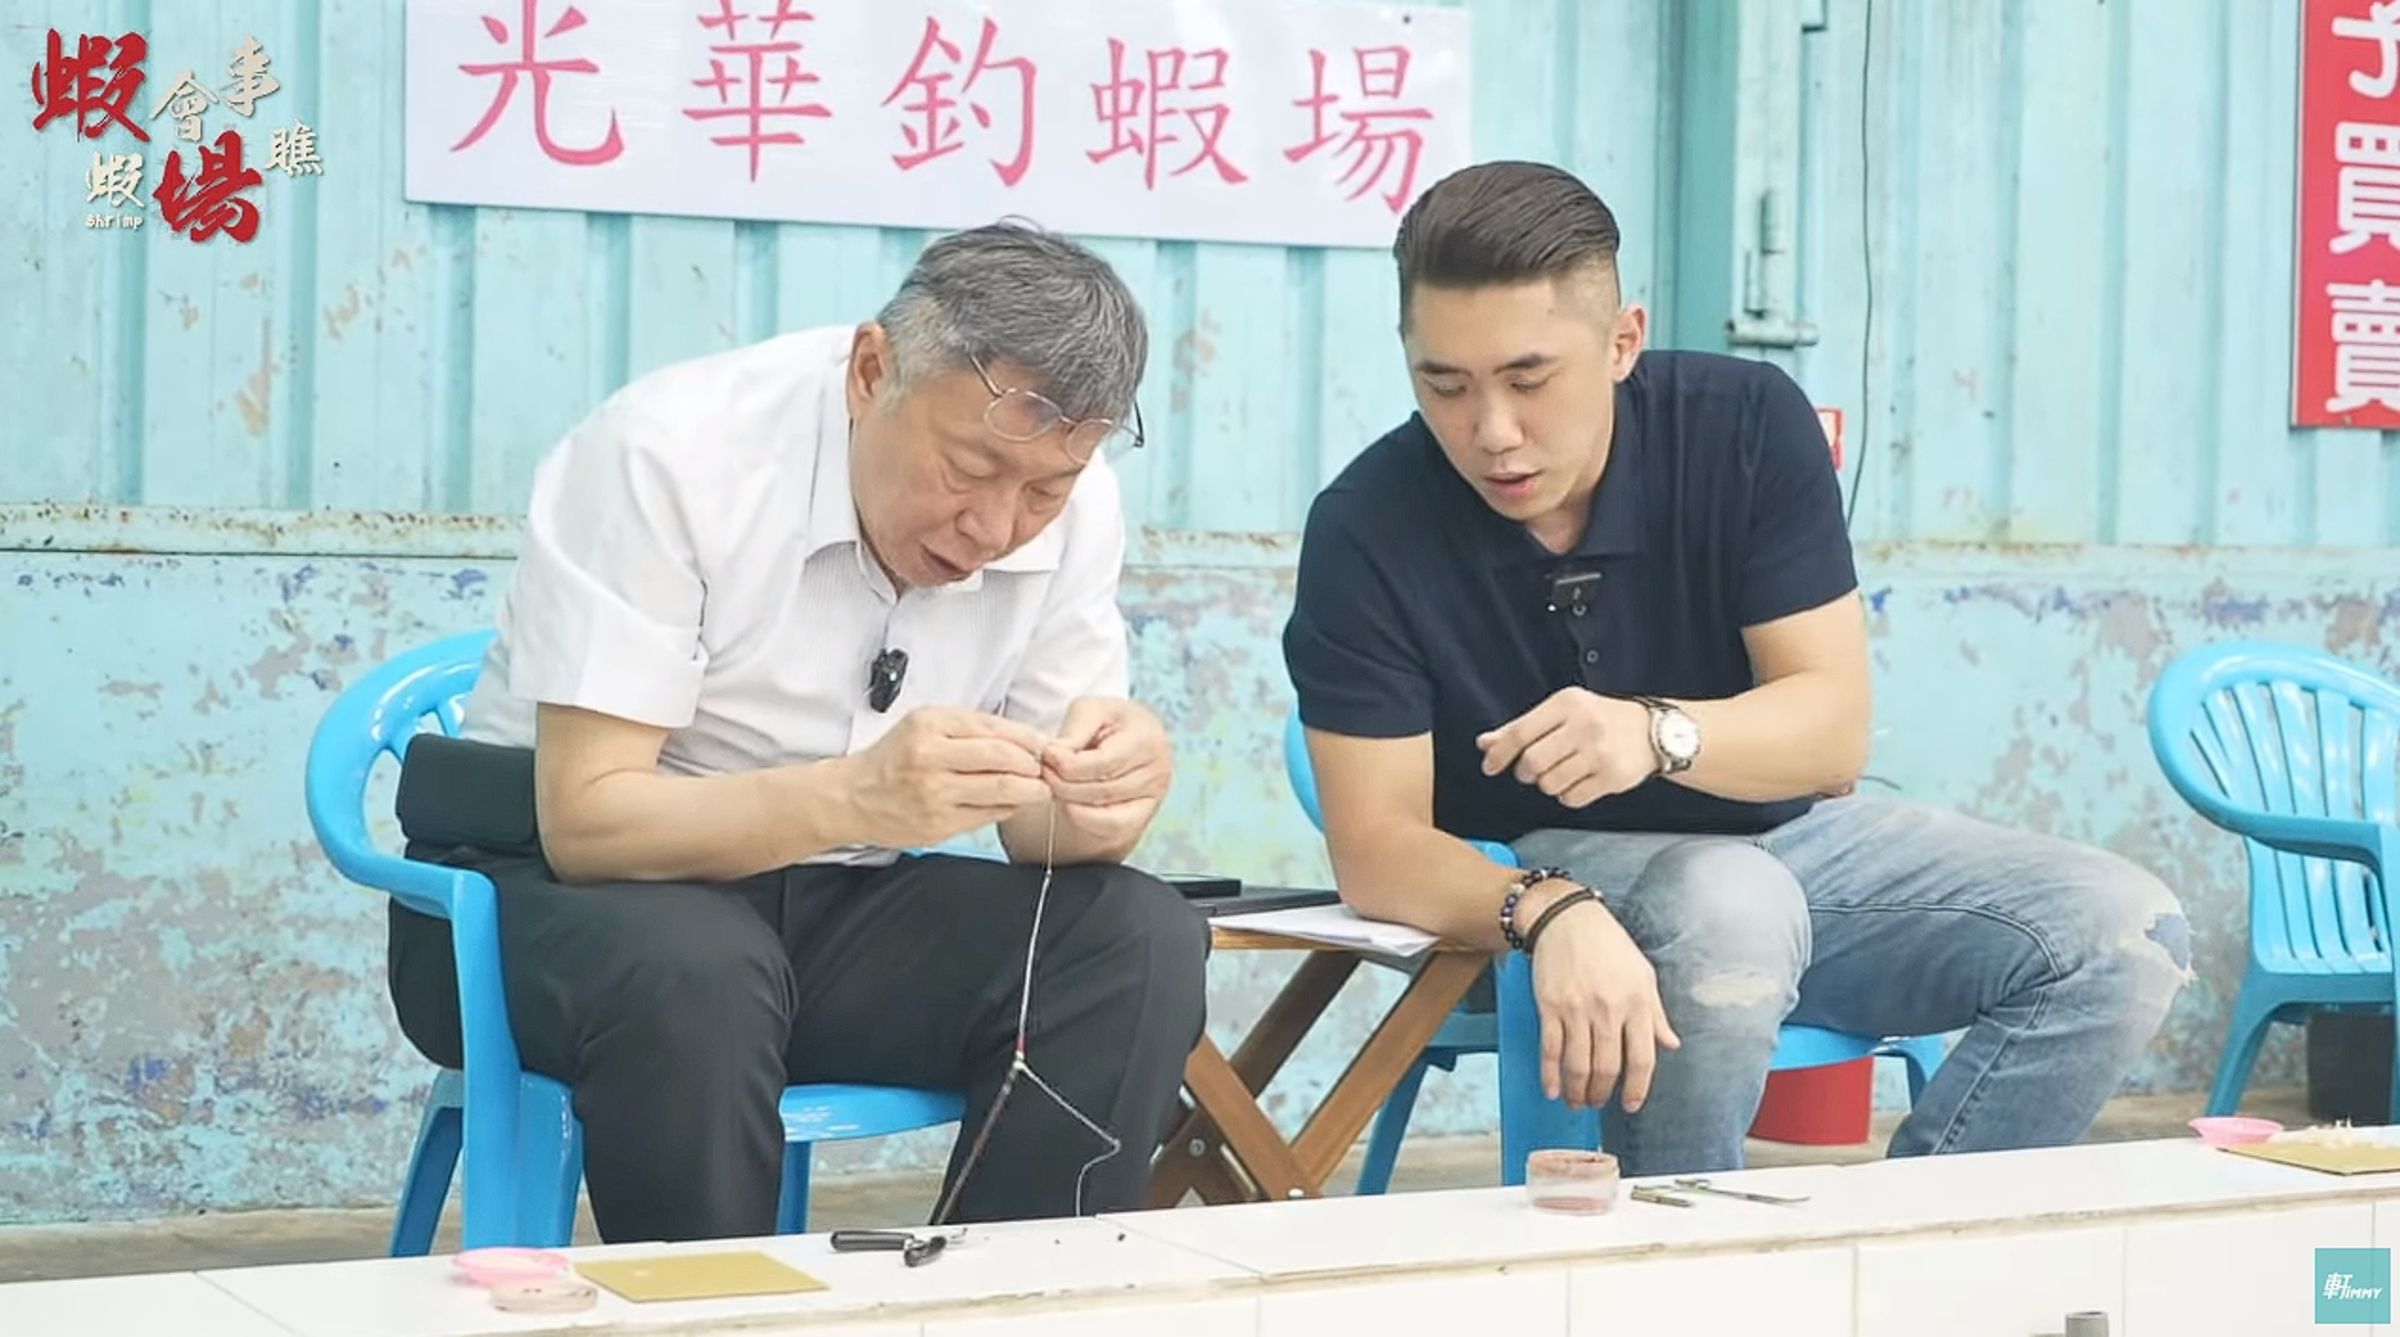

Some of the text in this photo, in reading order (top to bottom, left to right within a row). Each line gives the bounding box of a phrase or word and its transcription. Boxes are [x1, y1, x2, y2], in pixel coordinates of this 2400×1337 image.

[450, 0, 1434, 213] 光華釣蝦場
